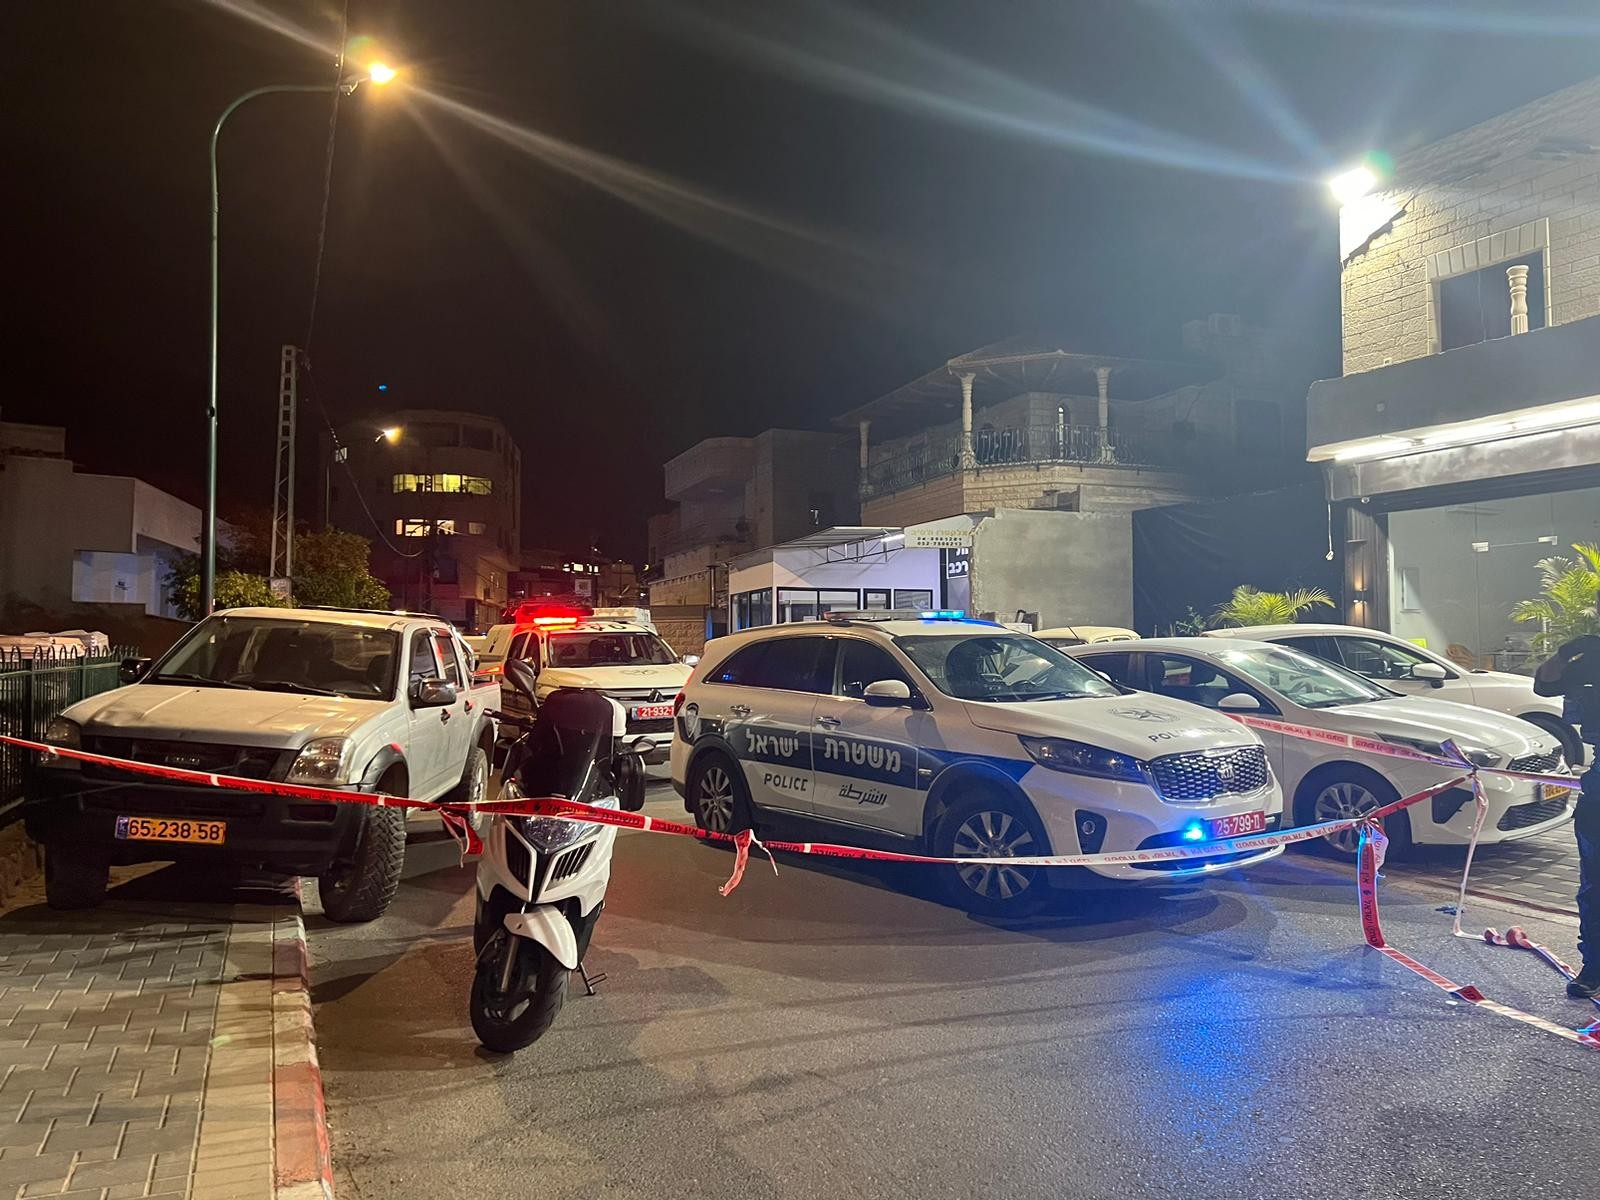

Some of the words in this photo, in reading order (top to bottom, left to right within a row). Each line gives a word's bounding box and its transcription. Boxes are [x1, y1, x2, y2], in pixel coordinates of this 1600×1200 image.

[746, 729, 799, 758] ישראל
[824, 738, 901, 773] משטרת
[764, 773, 808, 792] POLICE
[839, 784, 887, 806] الشرطة
